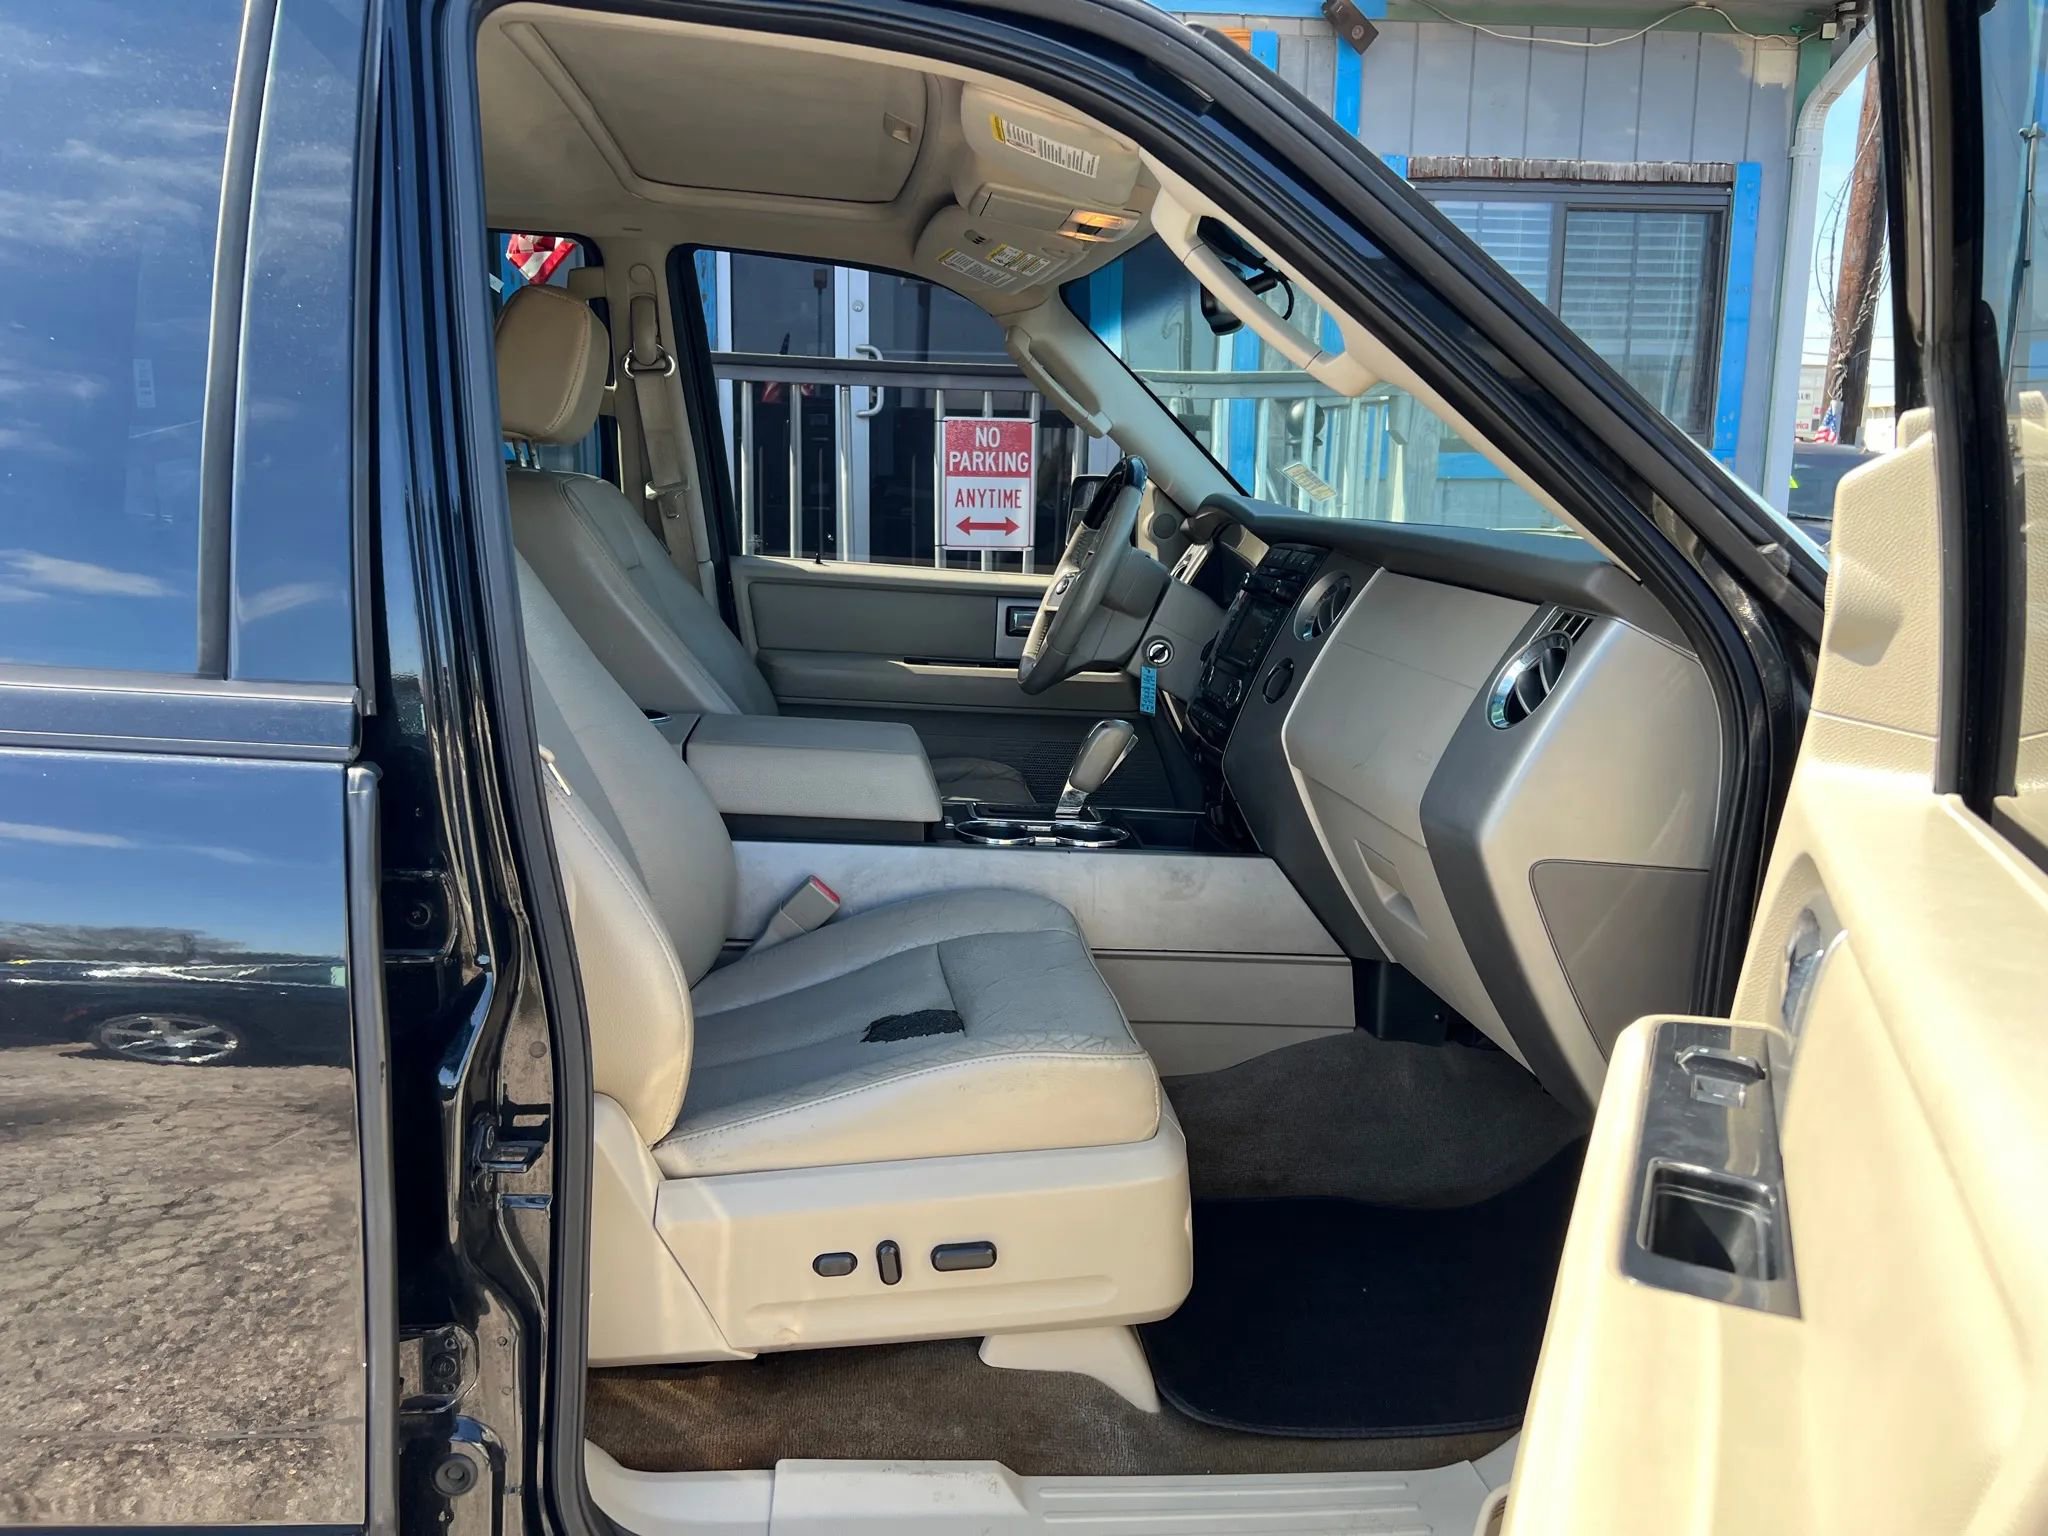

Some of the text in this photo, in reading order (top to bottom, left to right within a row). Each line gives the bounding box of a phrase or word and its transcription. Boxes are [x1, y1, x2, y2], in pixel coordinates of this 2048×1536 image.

[975, 427, 1000, 448] NO
[949, 451, 1029, 473] PARKING
[954, 488, 1022, 509] ANYTIME
